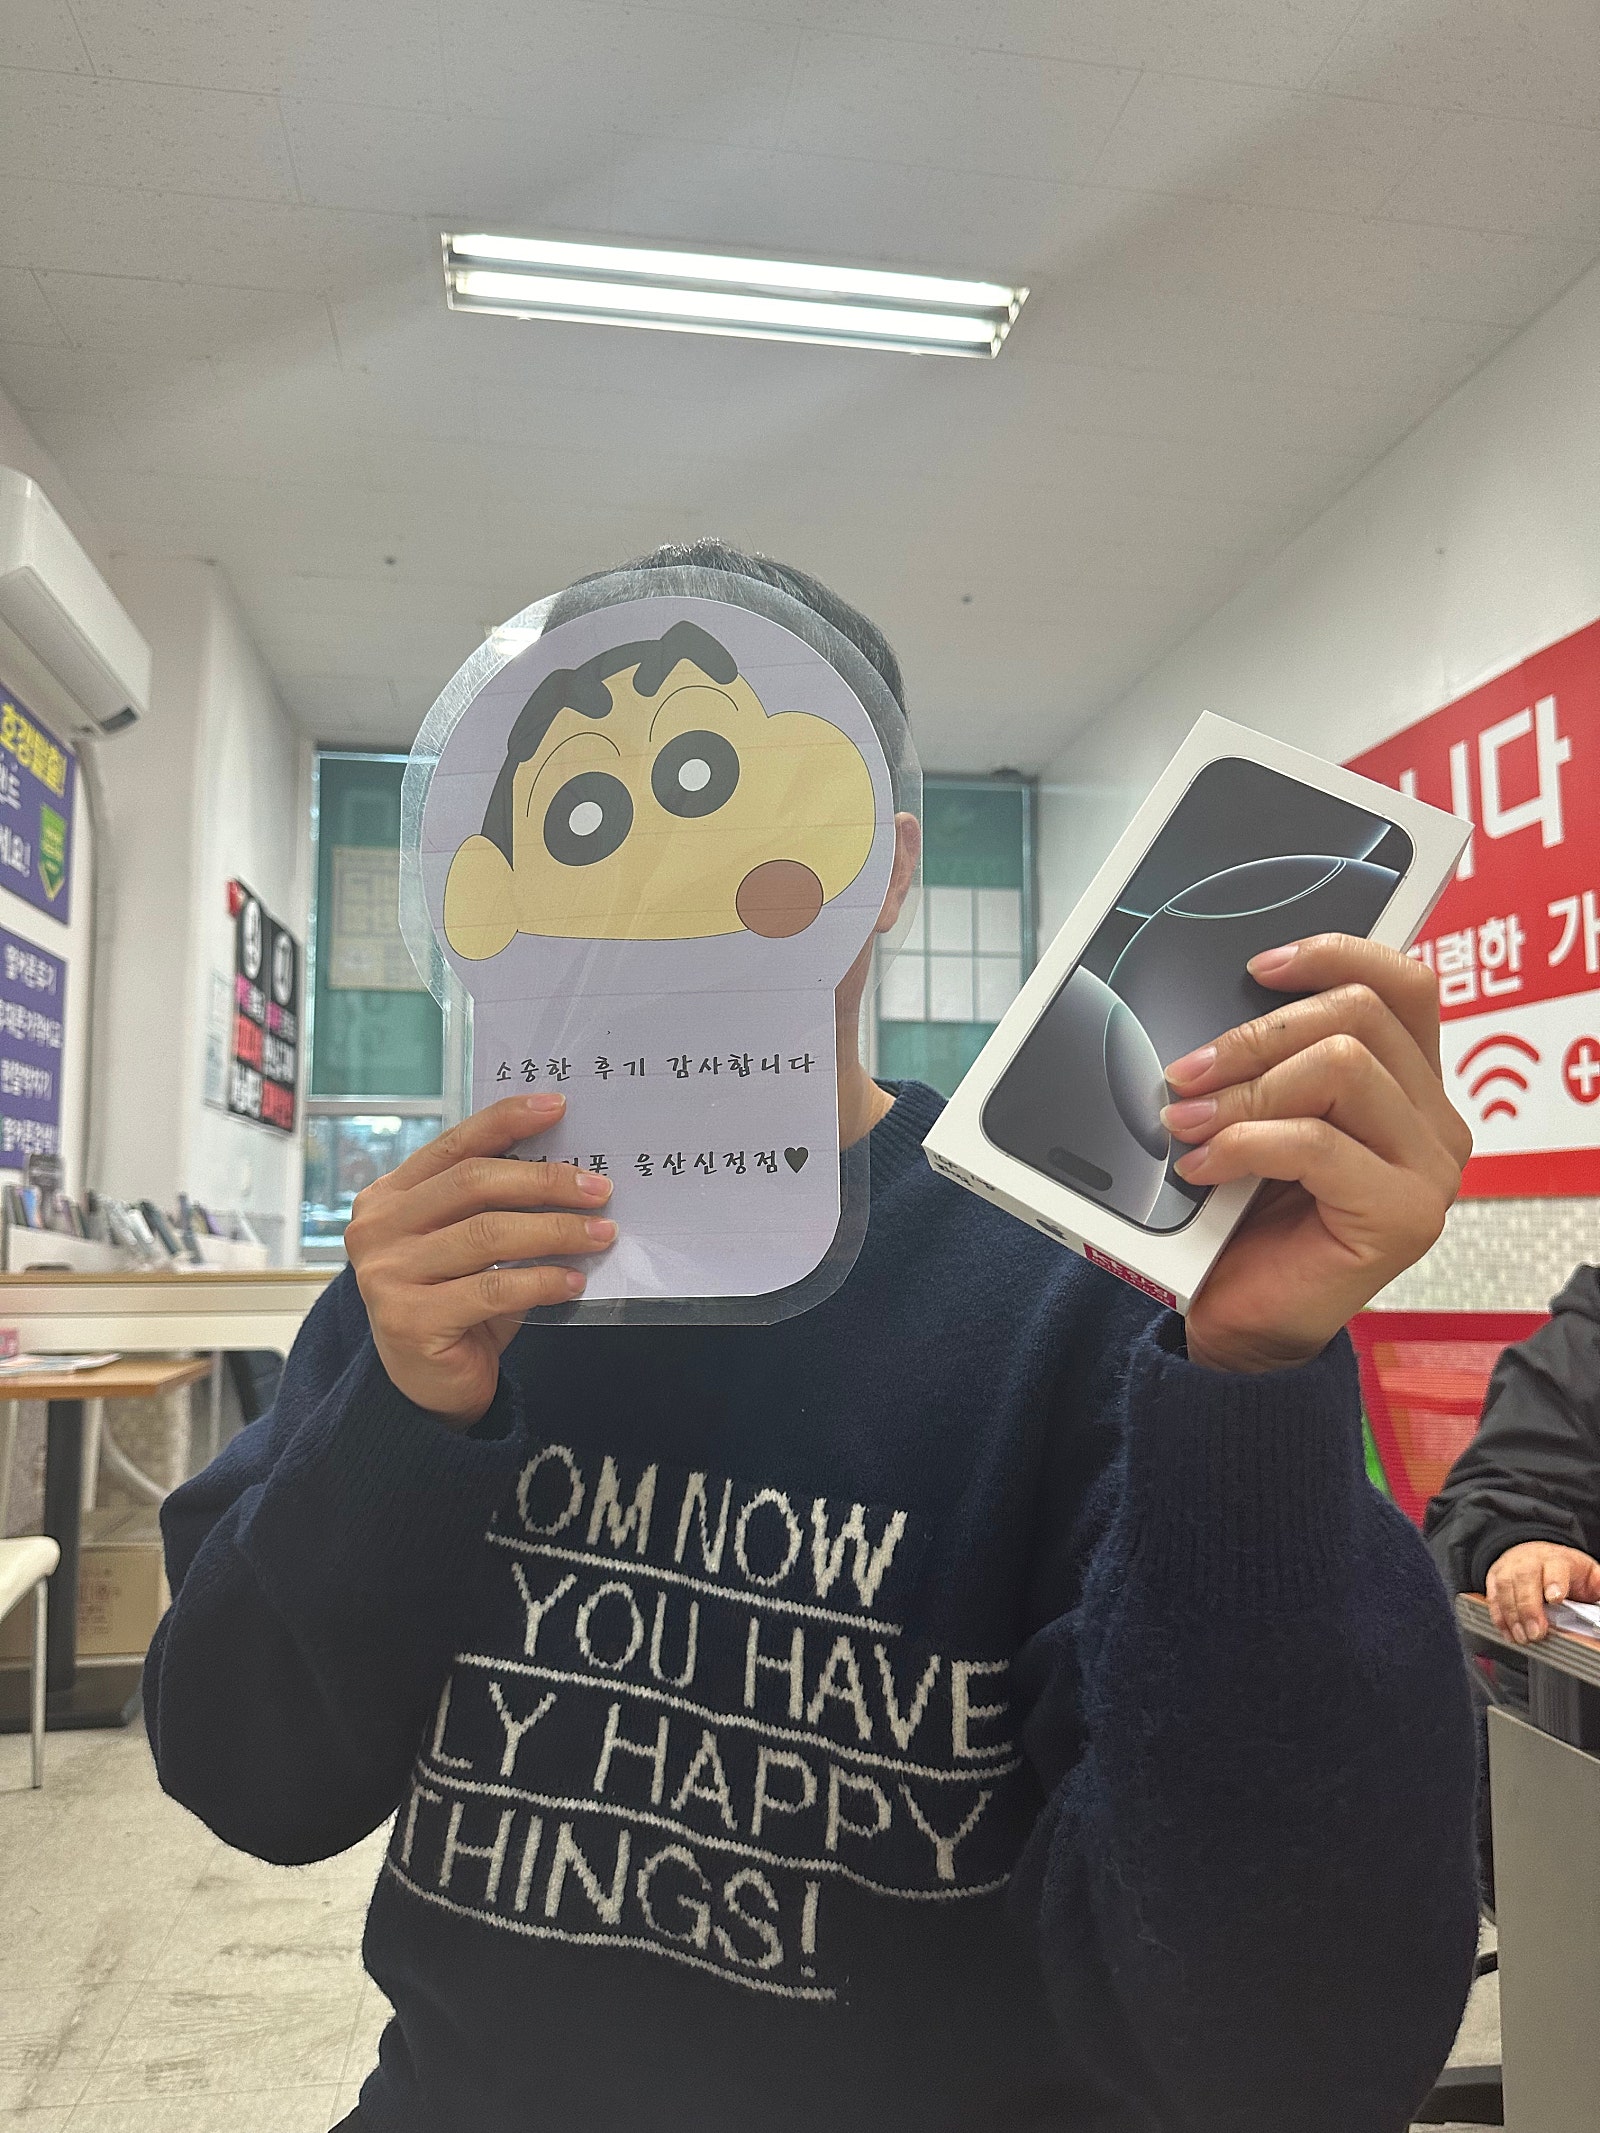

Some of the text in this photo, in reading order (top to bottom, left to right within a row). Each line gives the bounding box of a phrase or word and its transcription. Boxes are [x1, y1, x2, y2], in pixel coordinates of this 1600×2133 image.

[496, 1053, 816, 1082] 소중한 후기 감사합니다
[674, 1471, 908, 1608] NOW
[511, 1561, 1014, 1760] YOU HAVE
[593, 1702, 993, 1881] HAPPY
[400, 1784, 820, 1979] THINGS!
